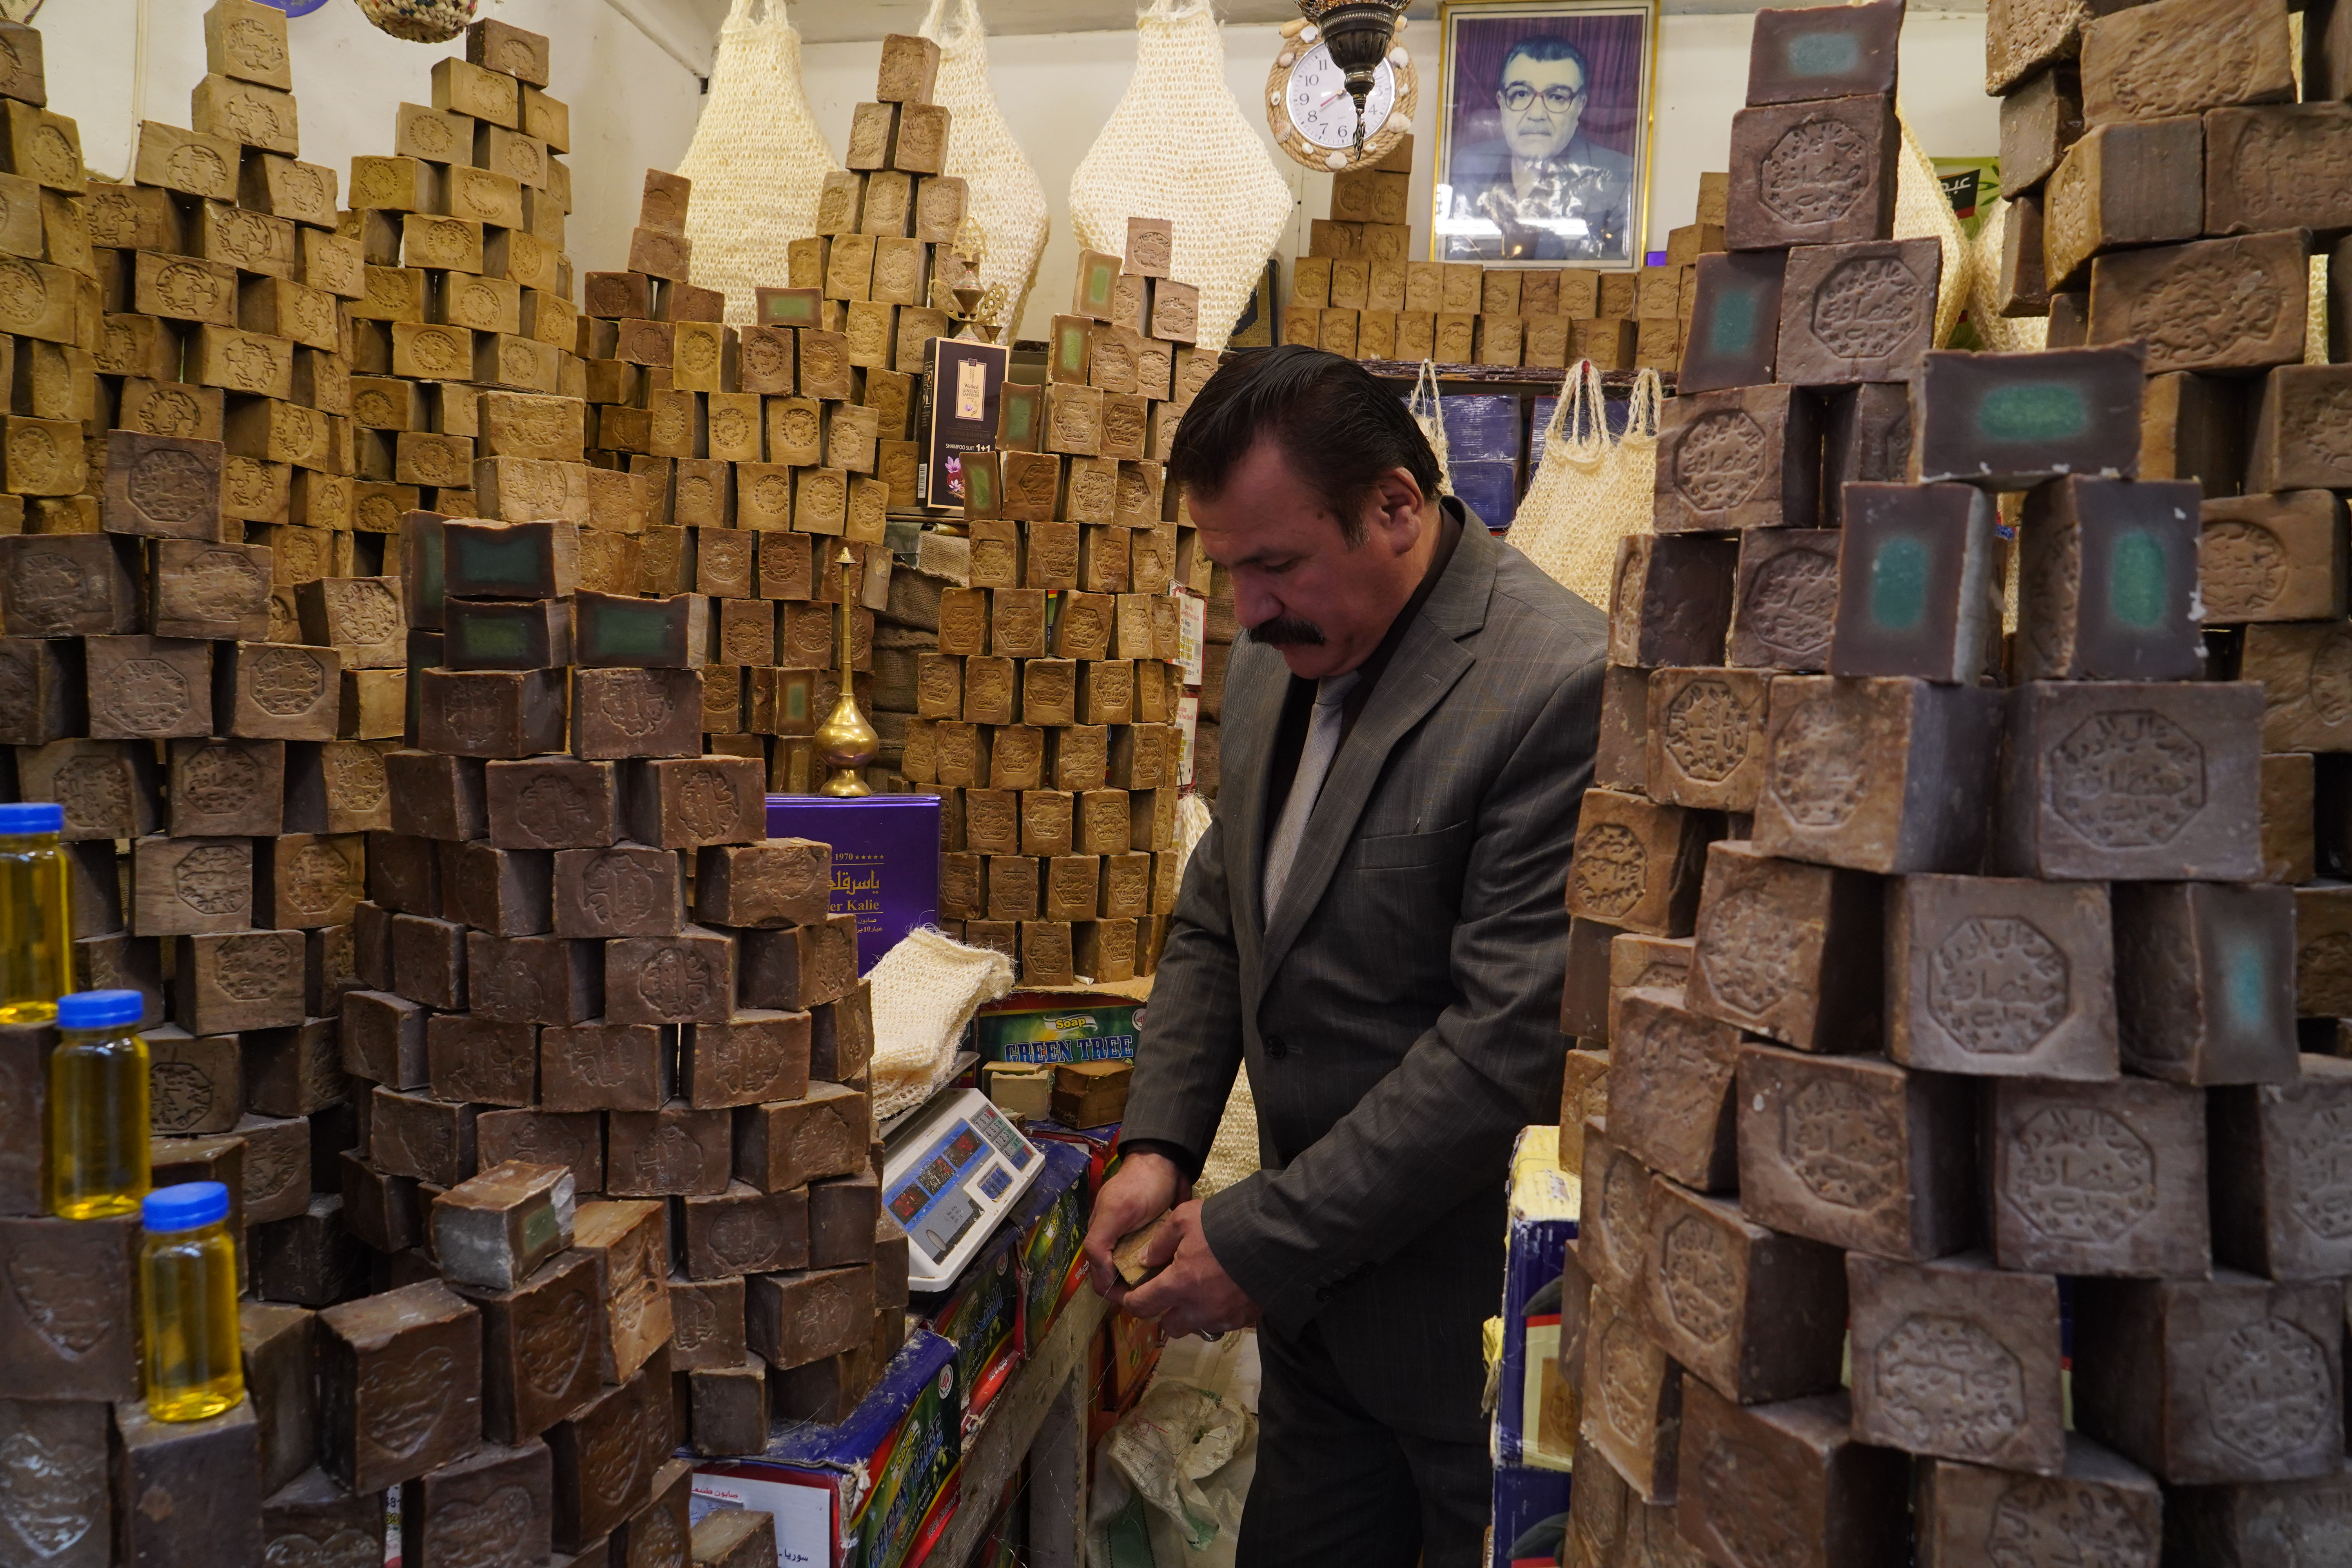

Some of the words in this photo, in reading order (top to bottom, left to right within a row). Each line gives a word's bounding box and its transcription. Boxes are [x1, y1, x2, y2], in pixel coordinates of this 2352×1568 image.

[1319, 59, 1327, 71] 11
[1305, 74, 1319, 86] 10
[1299, 93, 1309, 105] 9
[1368, 103, 1377, 115] 4
[1308, 111, 1317, 122] 8
[1319, 123, 1328, 134] 7
[1338, 125, 1347, 137] 6
[761, 365, 781, 377] ALEPPO
[803, 430, 818, 447] ALEPPO
[976, 444, 990, 452] 1+1
[769, 502, 789, 515] ALEPPO
[820, 505, 842, 517] ALEPPO
[846, 869, 880, 895] ياسر
[847, 900, 880, 911] Kalie
[1055, 1017, 1086, 1029] Soap
[1004, 1039, 1074, 1064] GREEN
[1077, 1035, 1134, 1061] TREE
[967, 1282, 1003, 1351] الشجرة
[897, 1429, 914, 1471] Soap
[715, 1488, 738, 1498] صابون
[868, 1473, 909, 1568] GREEN
[909, 1412, 943, 1493] TREE
[916, 1482, 931, 1505] Beauty
[914, 1509, 920, 1525] Of
[920, 1491, 933, 1515] Nature
[926, 1519, 940, 1539] 100%
[939, 1496, 956, 1523] Natural
[784, 1548, 808, 1562] سوريا
